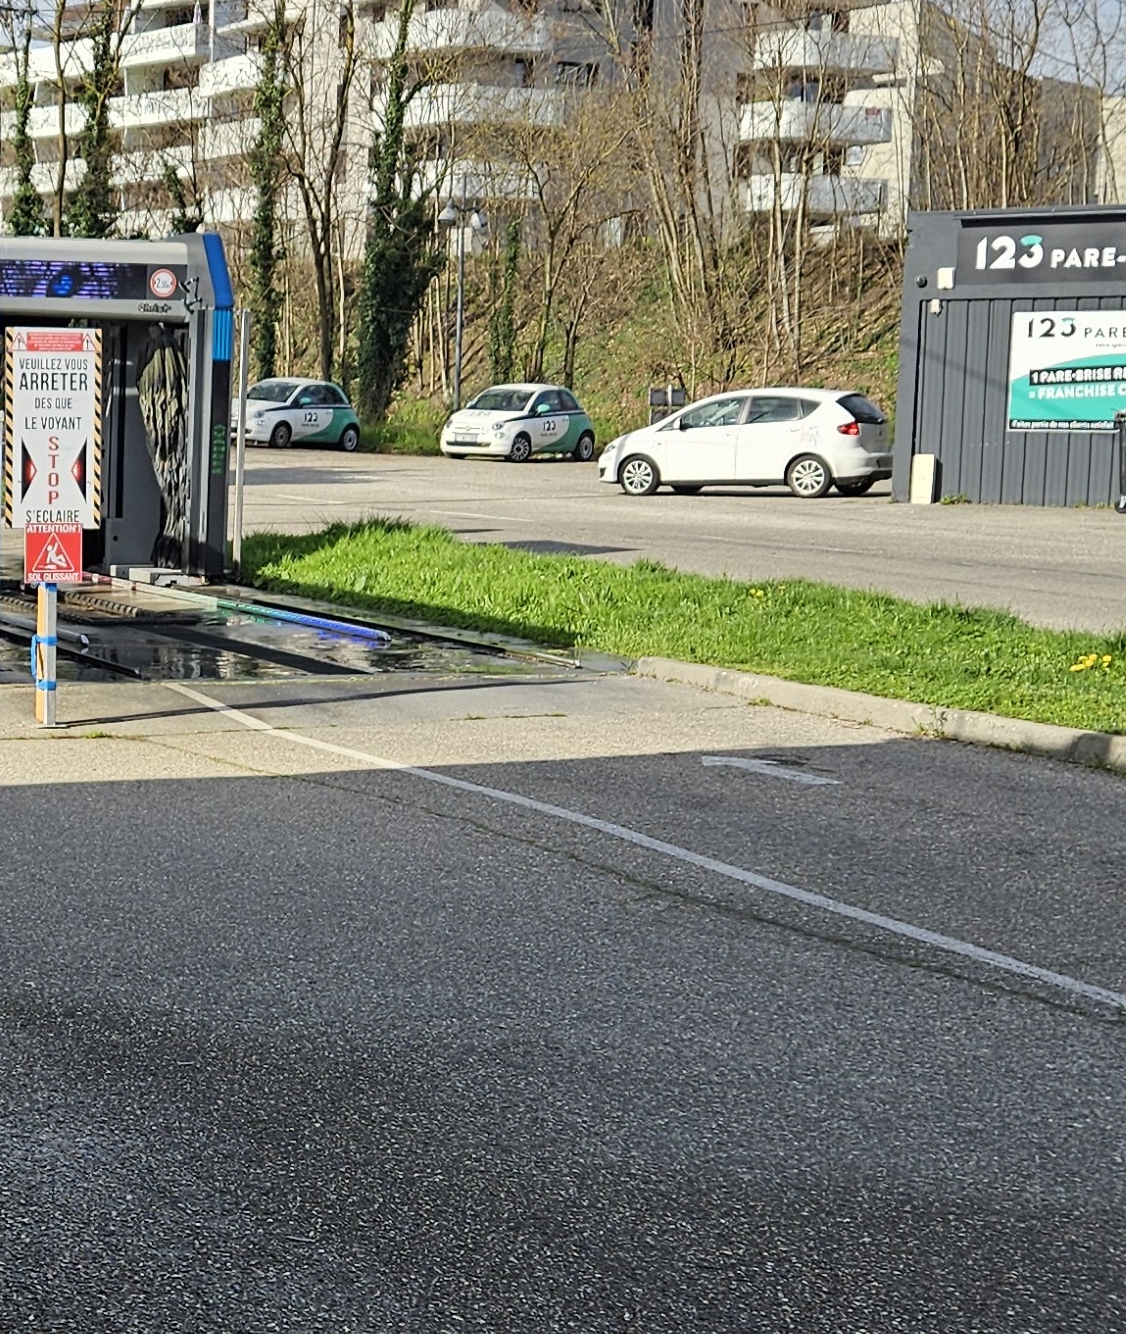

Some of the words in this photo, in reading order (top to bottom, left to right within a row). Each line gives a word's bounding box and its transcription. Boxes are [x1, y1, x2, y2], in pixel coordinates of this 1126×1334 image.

[976, 235, 1044, 269] 123
[1028, 318, 1076, 338] 123
[19, 358, 62, 370] VEUILLEZ
[65, 359, 88, 370] VOUS
[19, 373, 88, 391] ARRETER
[1032, 371, 1038, 383] 1
[1038, 385, 1115, 399] FRANCHISE
[35, 398, 52, 409] DES
[56, 398, 72, 409] QUE
[304, 412, 318, 422] 123
[25, 417, 37, 429] LE
[41, 417, 82, 430] VOYANT
[543, 420, 556, 431] 123
[26, 510, 80, 523] S'ECLAIRE
[28, 573, 42, 581] SOL
[43, 572, 79, 581] GLISSANT
